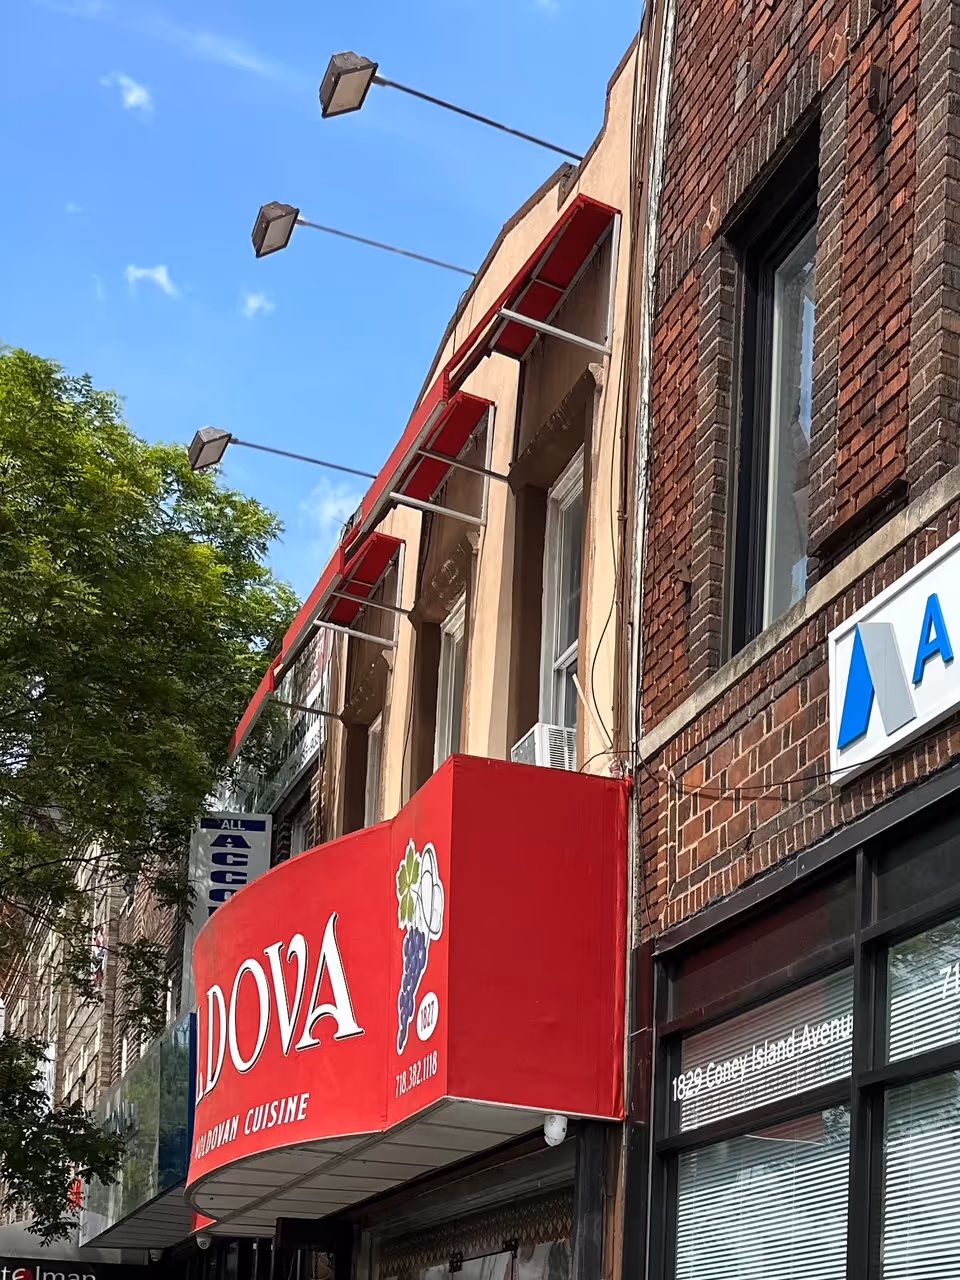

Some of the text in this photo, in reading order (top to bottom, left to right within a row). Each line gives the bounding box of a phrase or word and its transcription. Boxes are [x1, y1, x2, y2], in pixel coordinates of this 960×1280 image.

[221, 819, 246, 830] ALL
[396, 1050, 438, 1099] 718.382.1118
[672, 1067, 702, 1102] 1829
[706, 1055, 749, 1088] Coney
[751, 1028, 798, 1072] Island
[243, 1093, 310, 1136] CUISINE
